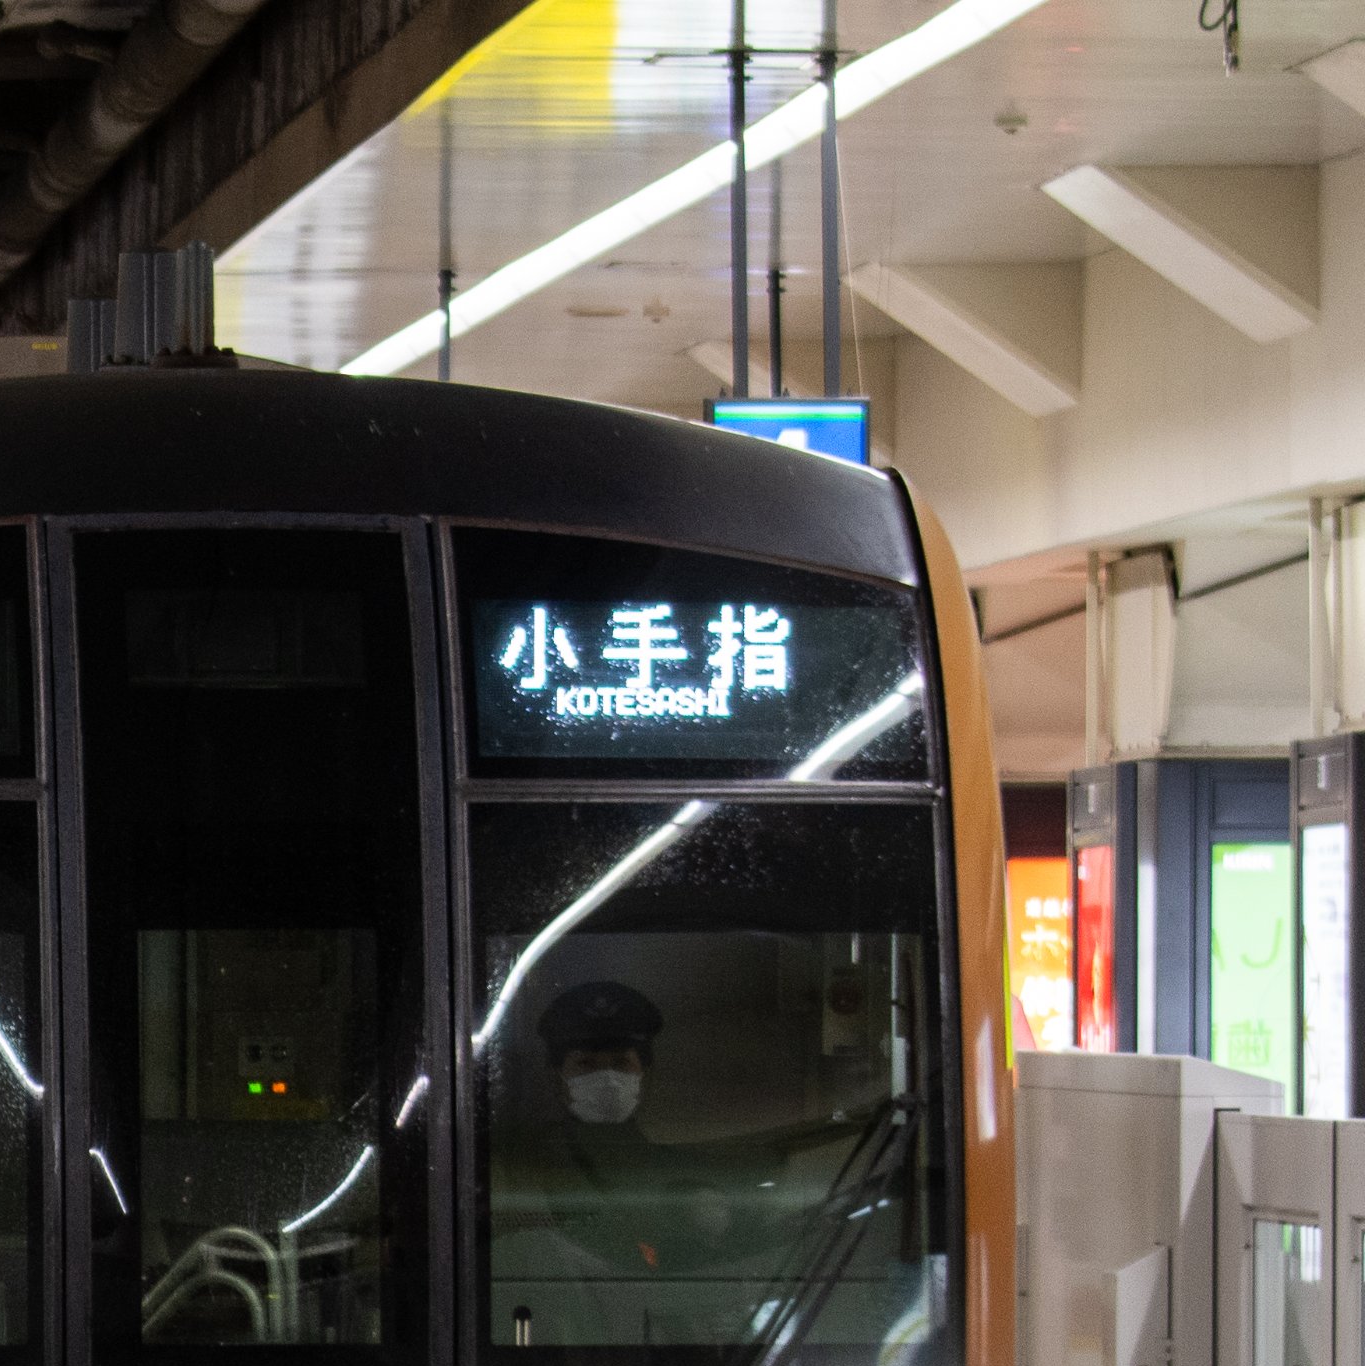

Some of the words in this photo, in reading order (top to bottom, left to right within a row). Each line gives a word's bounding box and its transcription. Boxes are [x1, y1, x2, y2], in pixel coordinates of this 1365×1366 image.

[500, 604, 791, 690] 小手指
[556, 687, 731, 717] KOTESASHI
